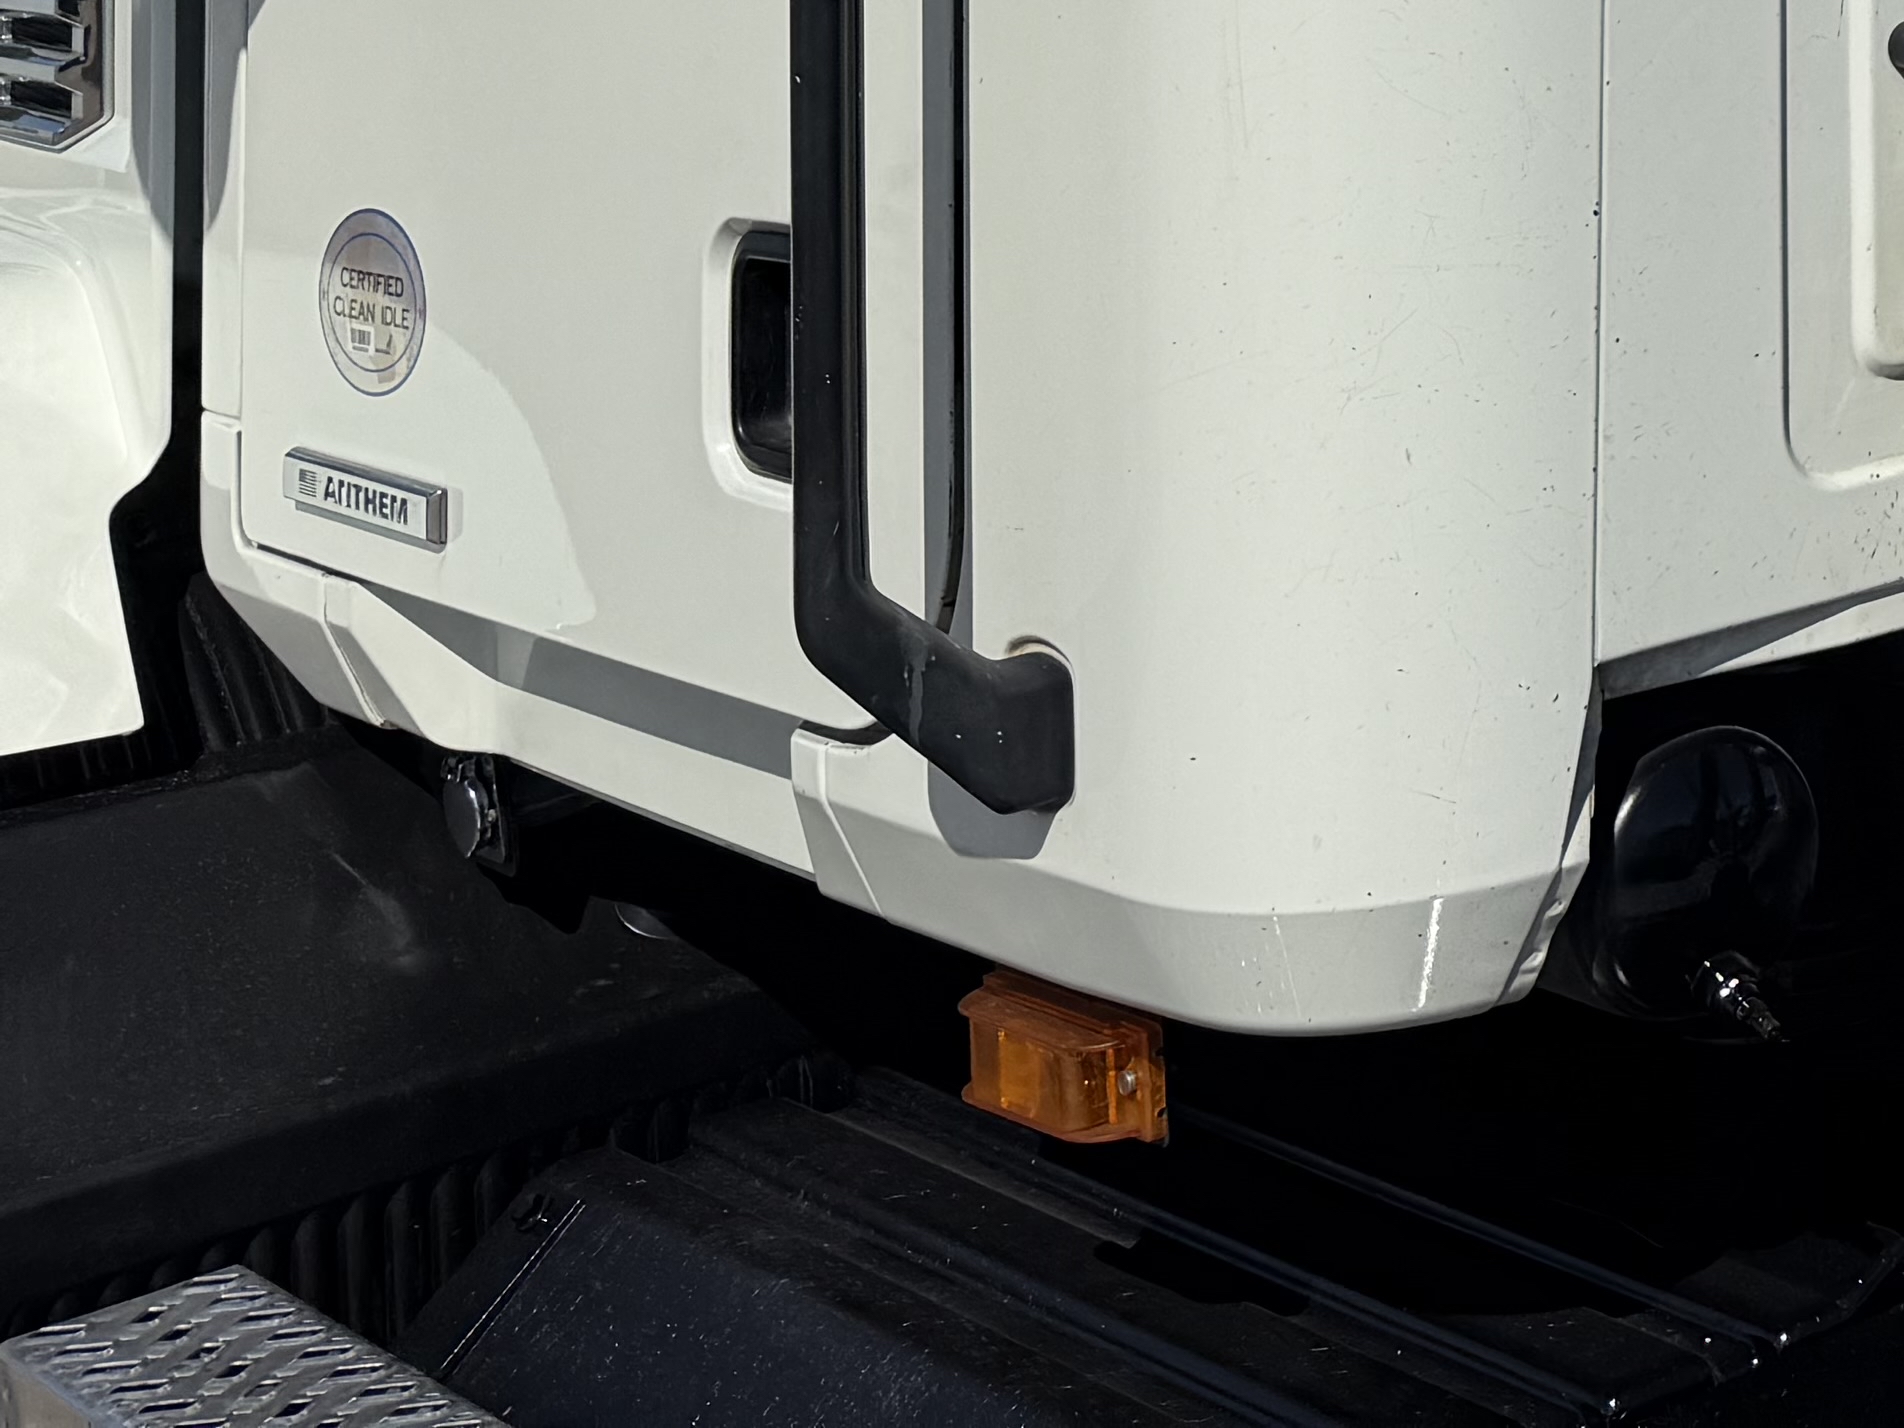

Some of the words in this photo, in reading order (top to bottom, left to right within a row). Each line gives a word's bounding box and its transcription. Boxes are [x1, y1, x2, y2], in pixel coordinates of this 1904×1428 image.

[340, 266, 404, 298] CERTIFIED
[333, 294, 375, 324] CLEAN
[381, 305, 410, 331] IDLE
[323, 475, 409, 526] ANTHEM
